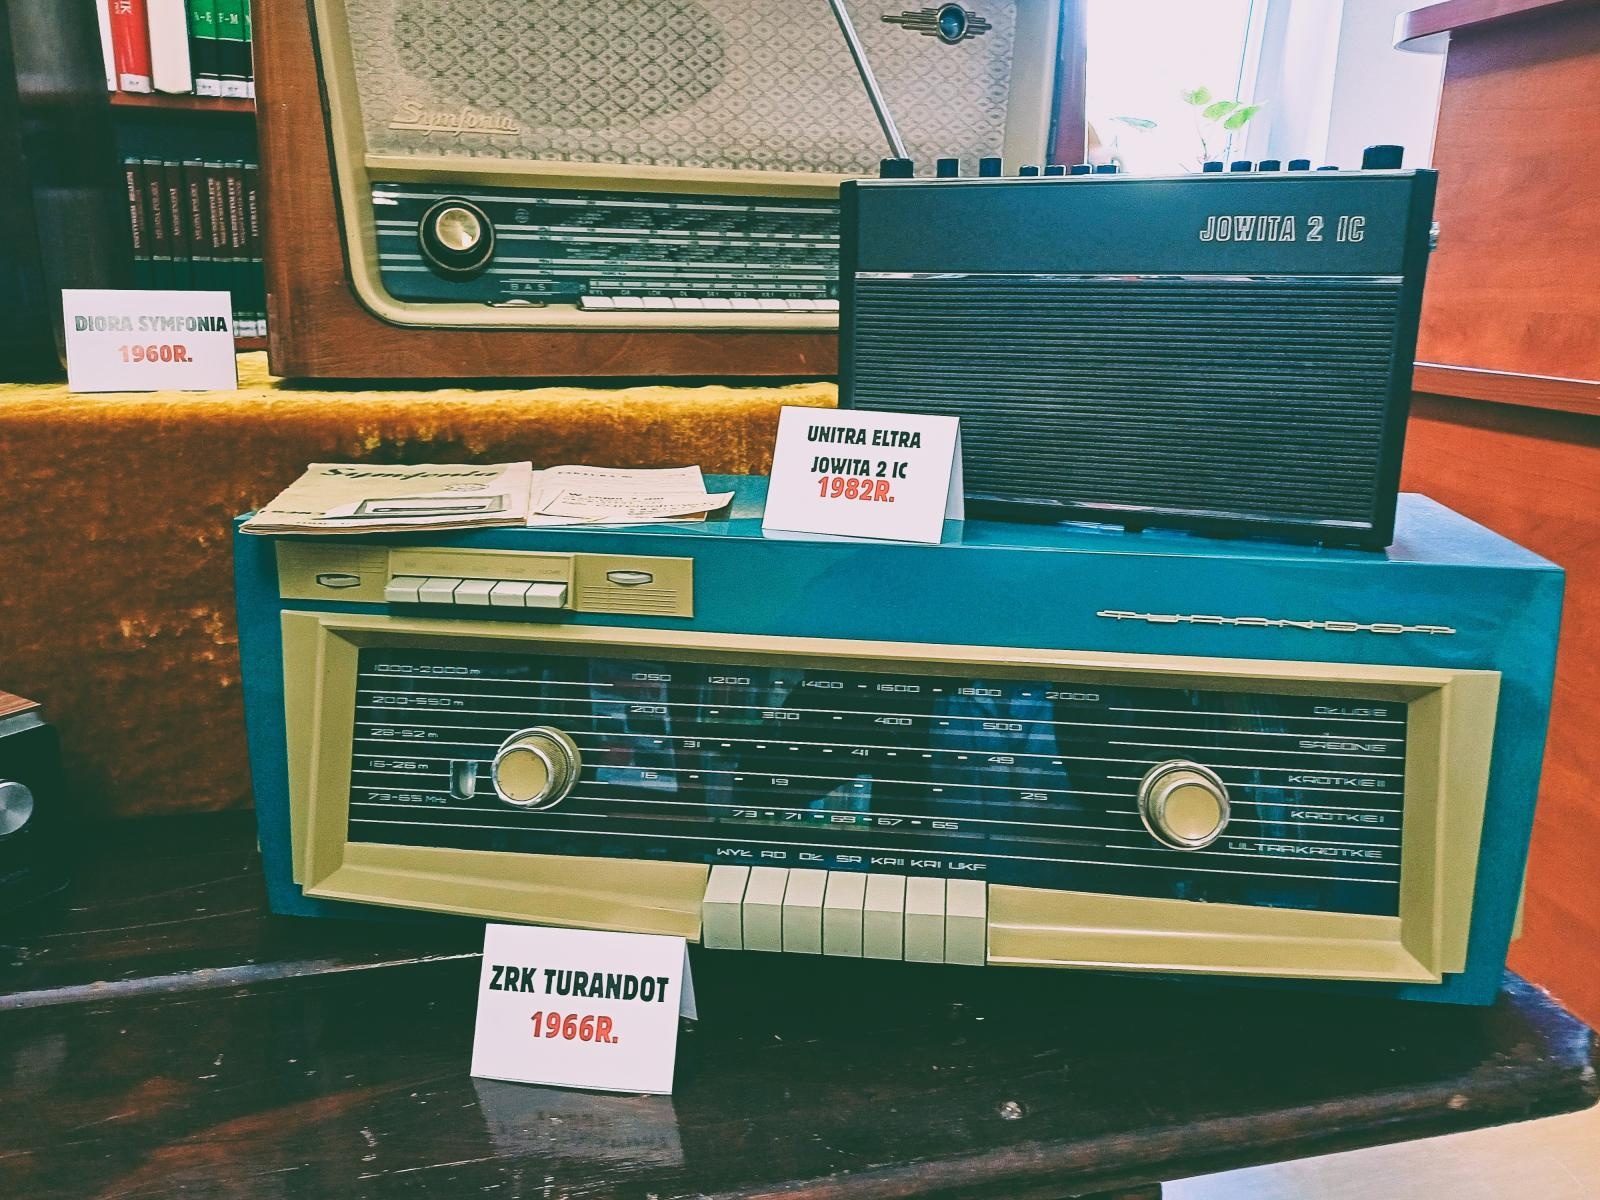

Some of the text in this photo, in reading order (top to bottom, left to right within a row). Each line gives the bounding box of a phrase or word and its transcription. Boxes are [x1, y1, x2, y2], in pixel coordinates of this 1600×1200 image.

[1200, 215, 1366, 242] JOWITA 2 IC
[74, 315, 134, 332] DIORA
[138, 315, 228, 332] SYMFONIA
[118, 344, 193, 363] 1960R.
[807, 425, 921, 448] UNITRA ELTRA
[811, 456, 908, 479] JOWITA 2 IC
[818, 476, 895, 503] 1982R.
[631, 672, 672, 683] 1050
[708, 675, 751, 686] 1200
[802, 679, 844, 690] 1400
[1045, 690, 1100, 702] 2000
[630, 704, 668, 715] 200
[874, 716, 913, 727] 400
[851, 747, 870, 758] 41
[731, 809, 758, 819] 73
[784, 812, 803, 821] 71
[489, 965, 669, 1003] ZRK TURANDOT
[531, 1011, 619, 1044] 1966R.
